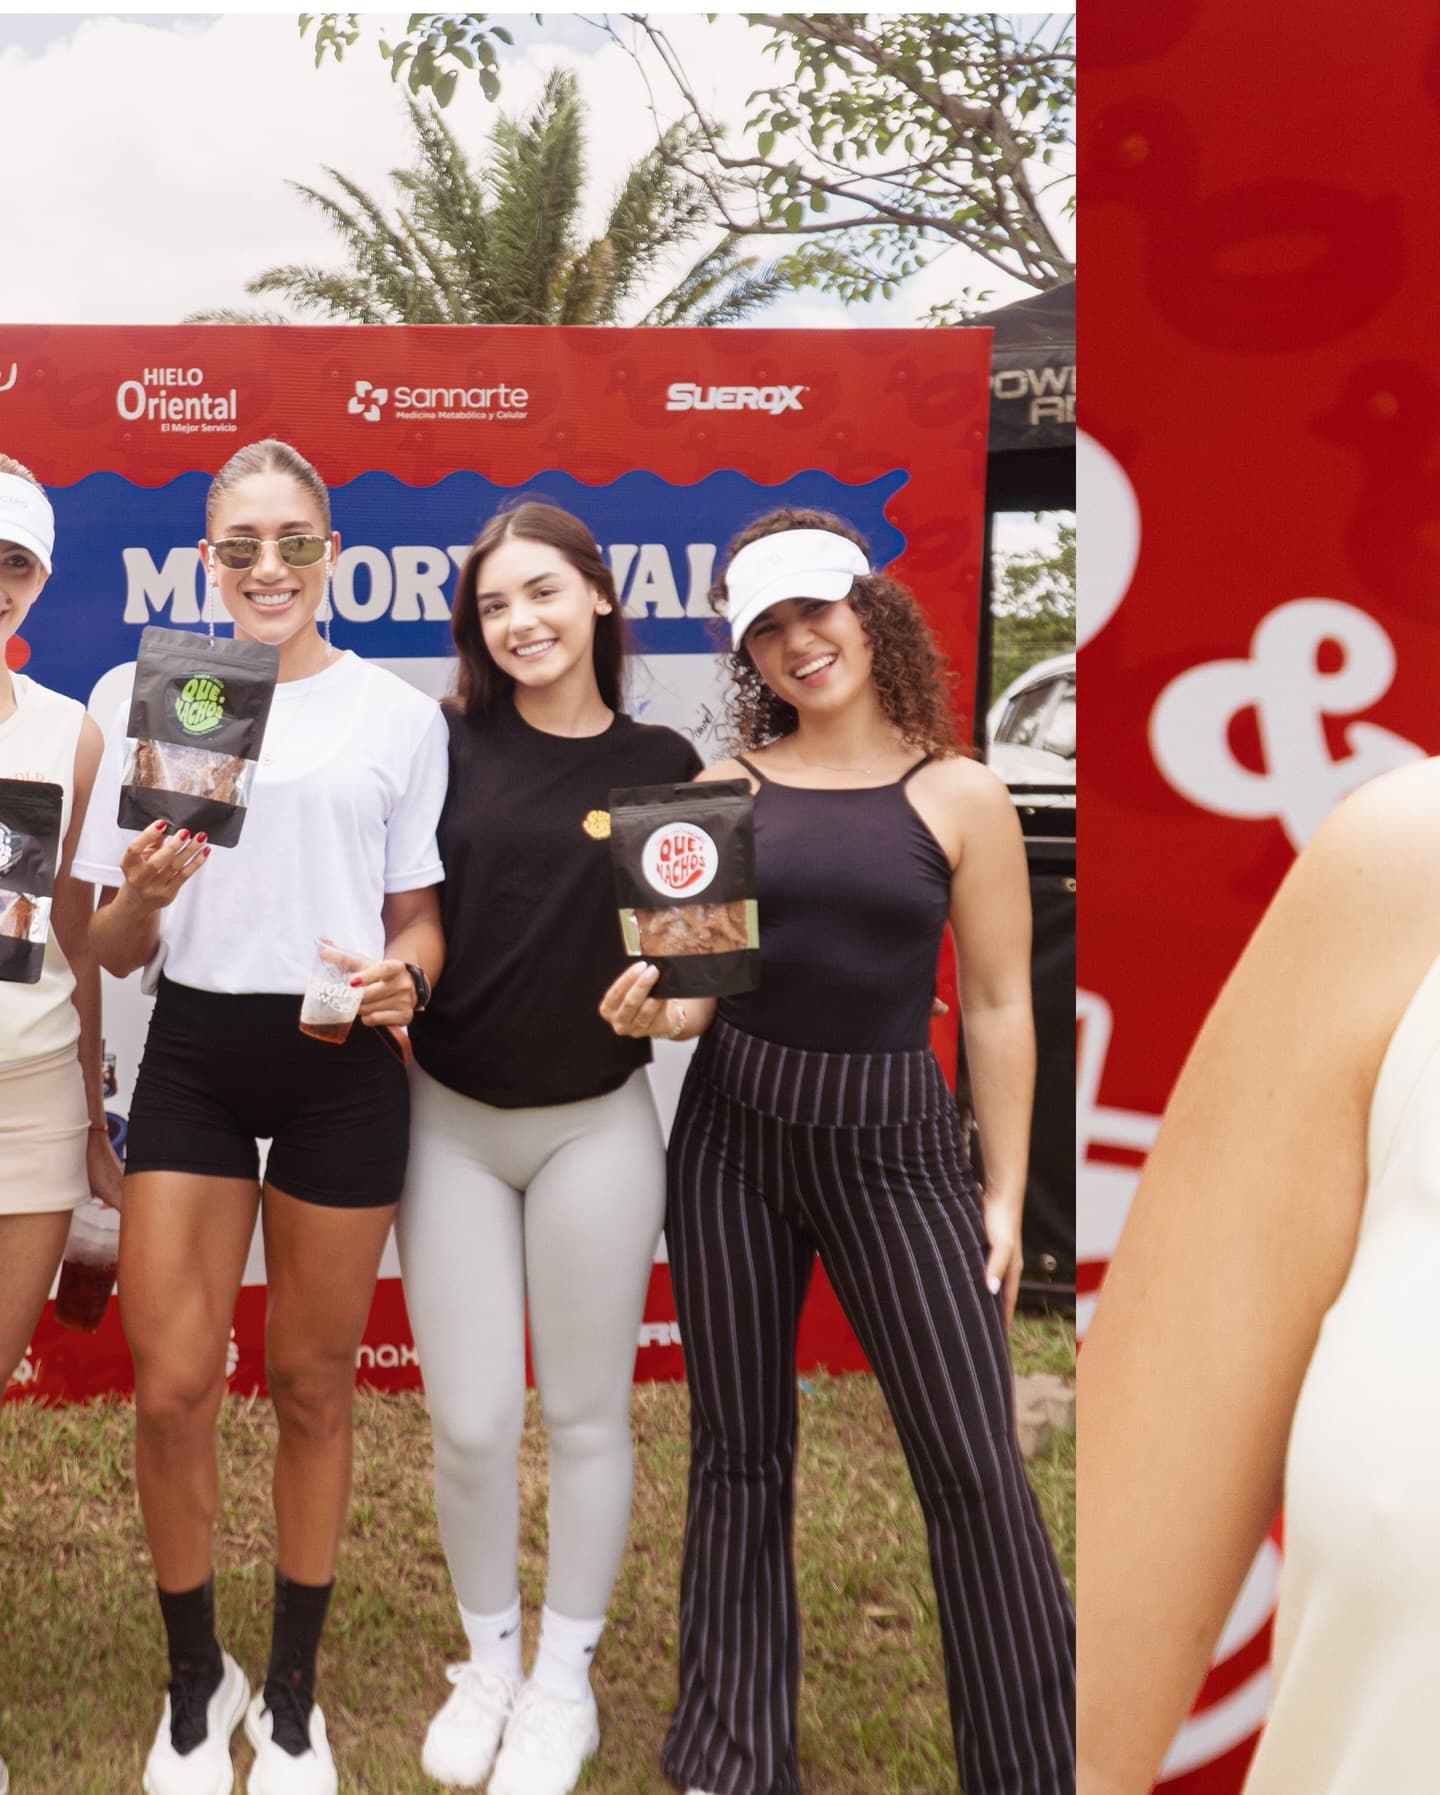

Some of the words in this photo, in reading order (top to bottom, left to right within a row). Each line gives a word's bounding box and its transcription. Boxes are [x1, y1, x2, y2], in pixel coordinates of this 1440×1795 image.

[143, 367, 203, 386] HIELO
[116, 379, 237, 420] Oriental
[394, 383, 529, 408] sannarte
[161, 423, 170, 432] El
[171, 423, 199, 434] Mejor
[201, 423, 237, 432] Servicio
